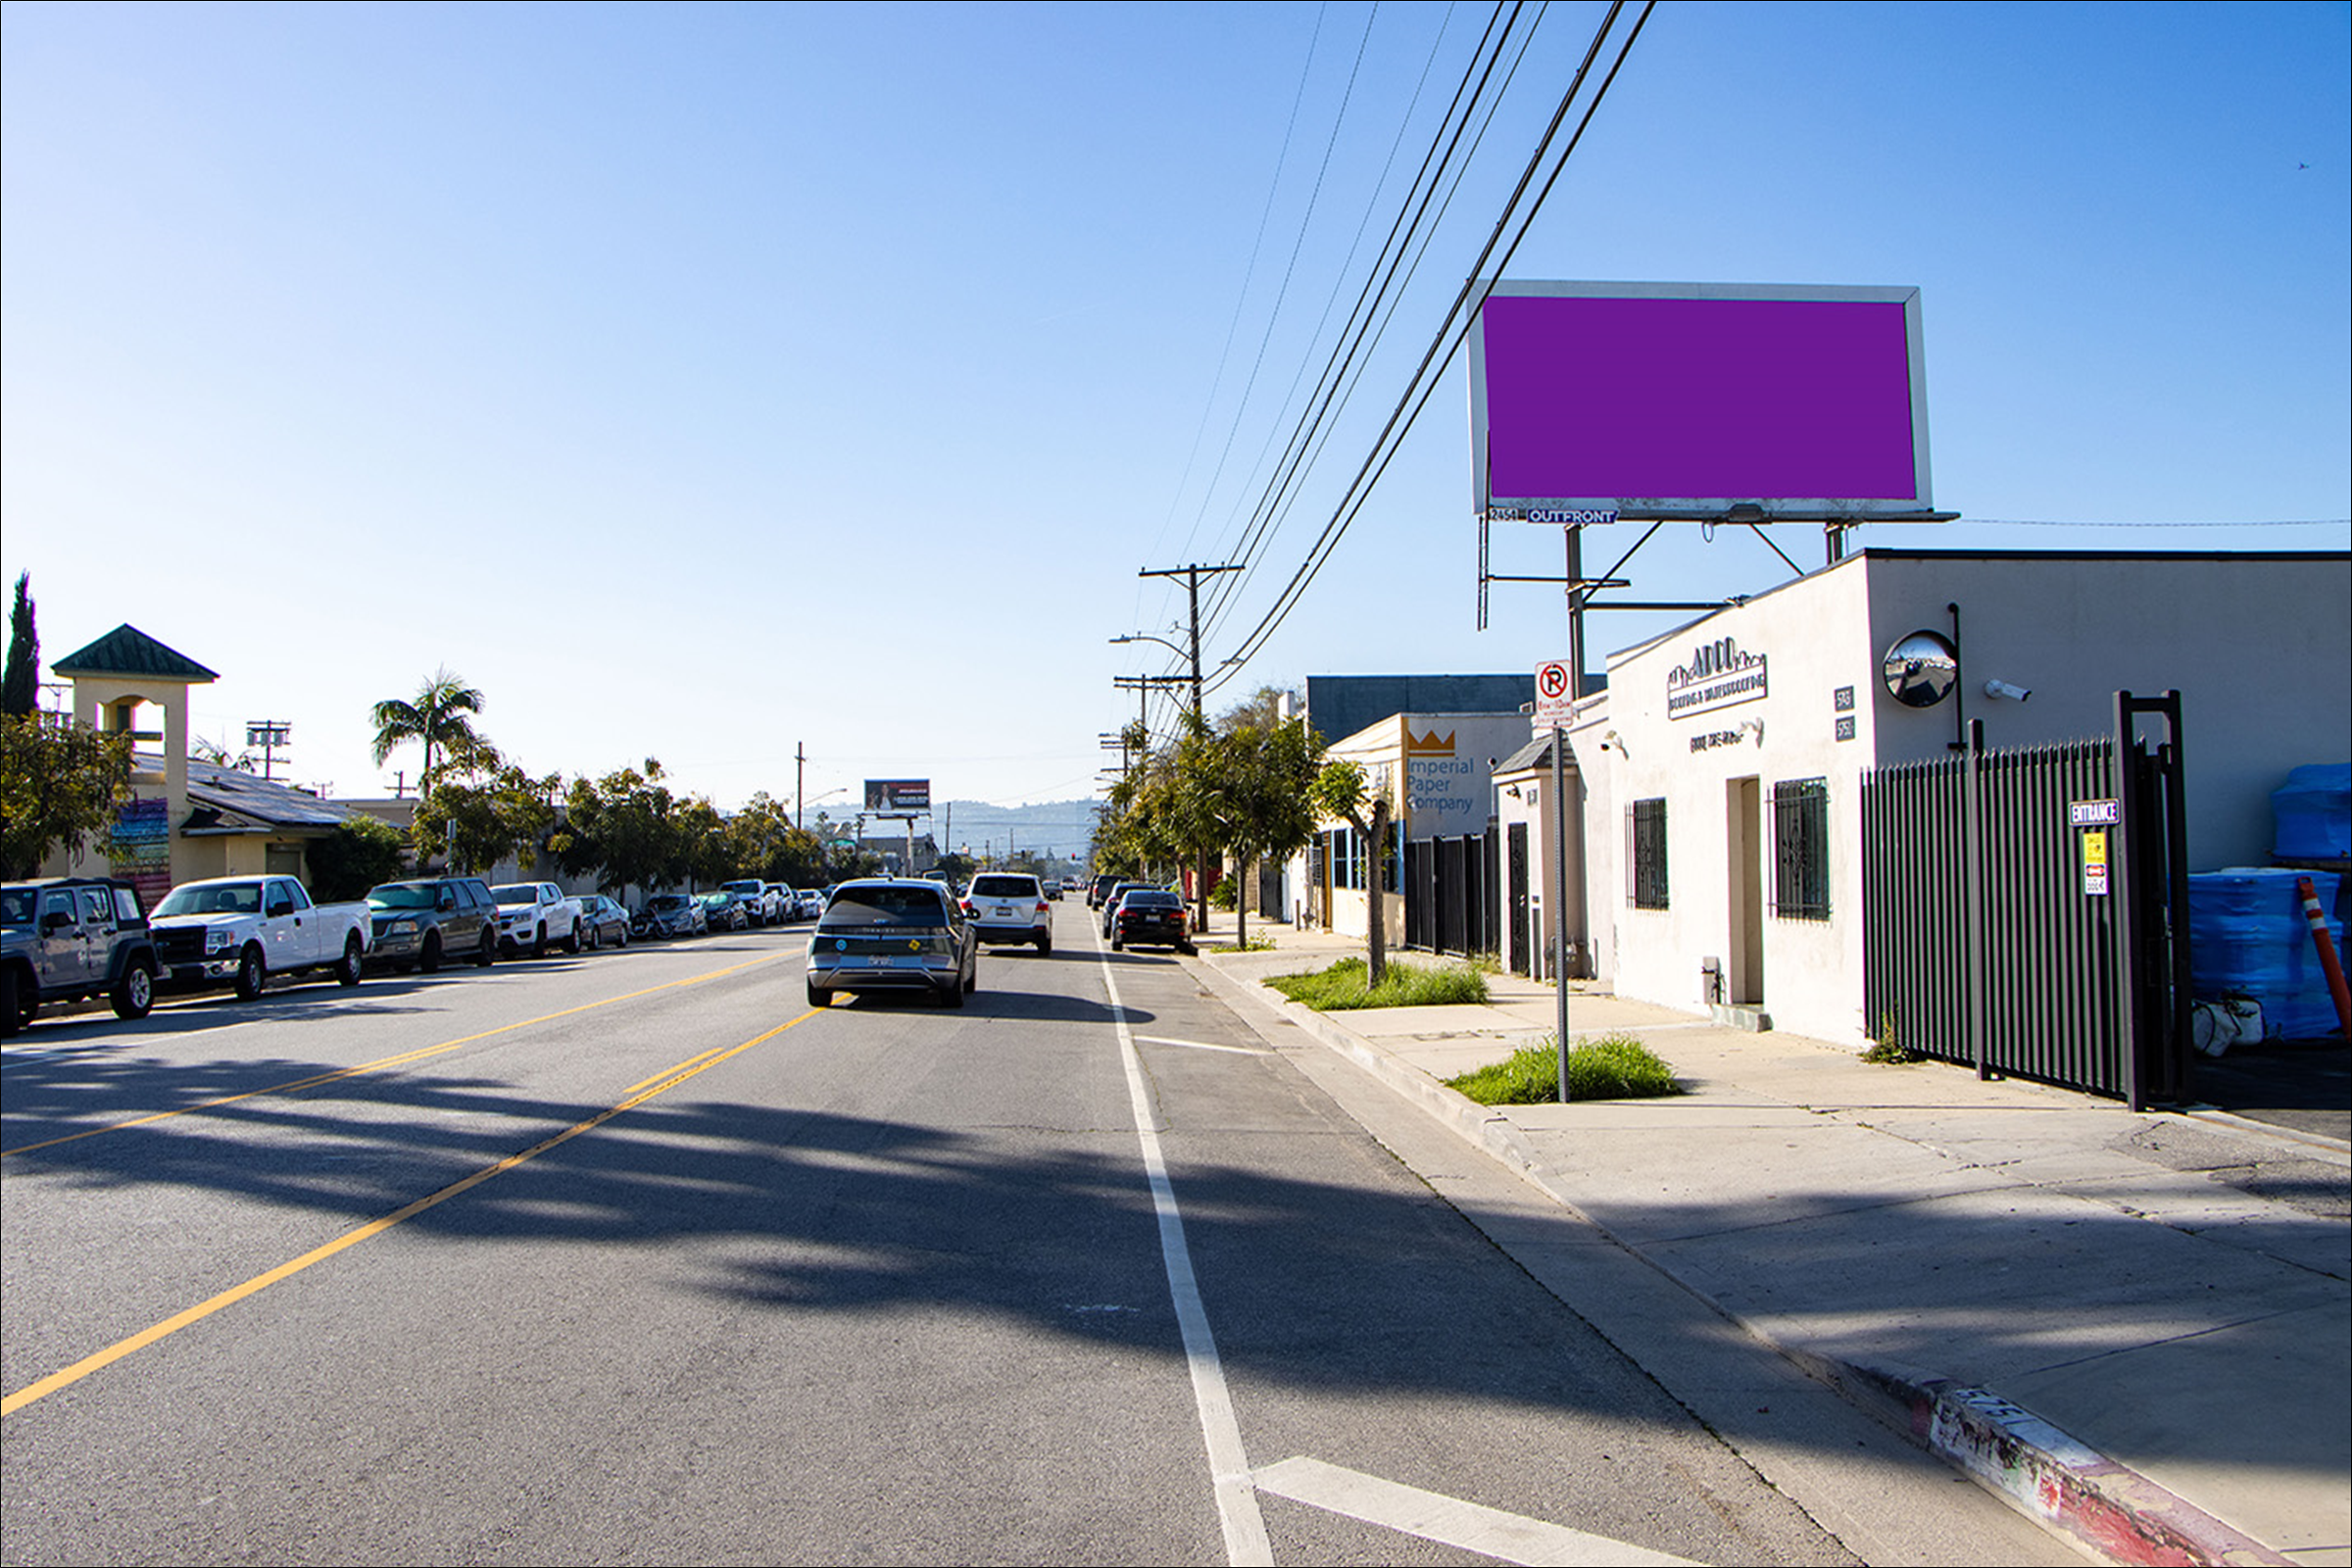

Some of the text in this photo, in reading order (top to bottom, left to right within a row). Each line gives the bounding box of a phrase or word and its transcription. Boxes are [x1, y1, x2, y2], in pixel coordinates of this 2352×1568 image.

[1529, 510, 1616, 522] OUTFRONT
[1406, 757, 1474, 776] Imperial
[1406, 774, 1450, 795] Paper
[1406, 794, 1473, 815] Company
[2072, 802, 2118, 822] ENTRANCE
